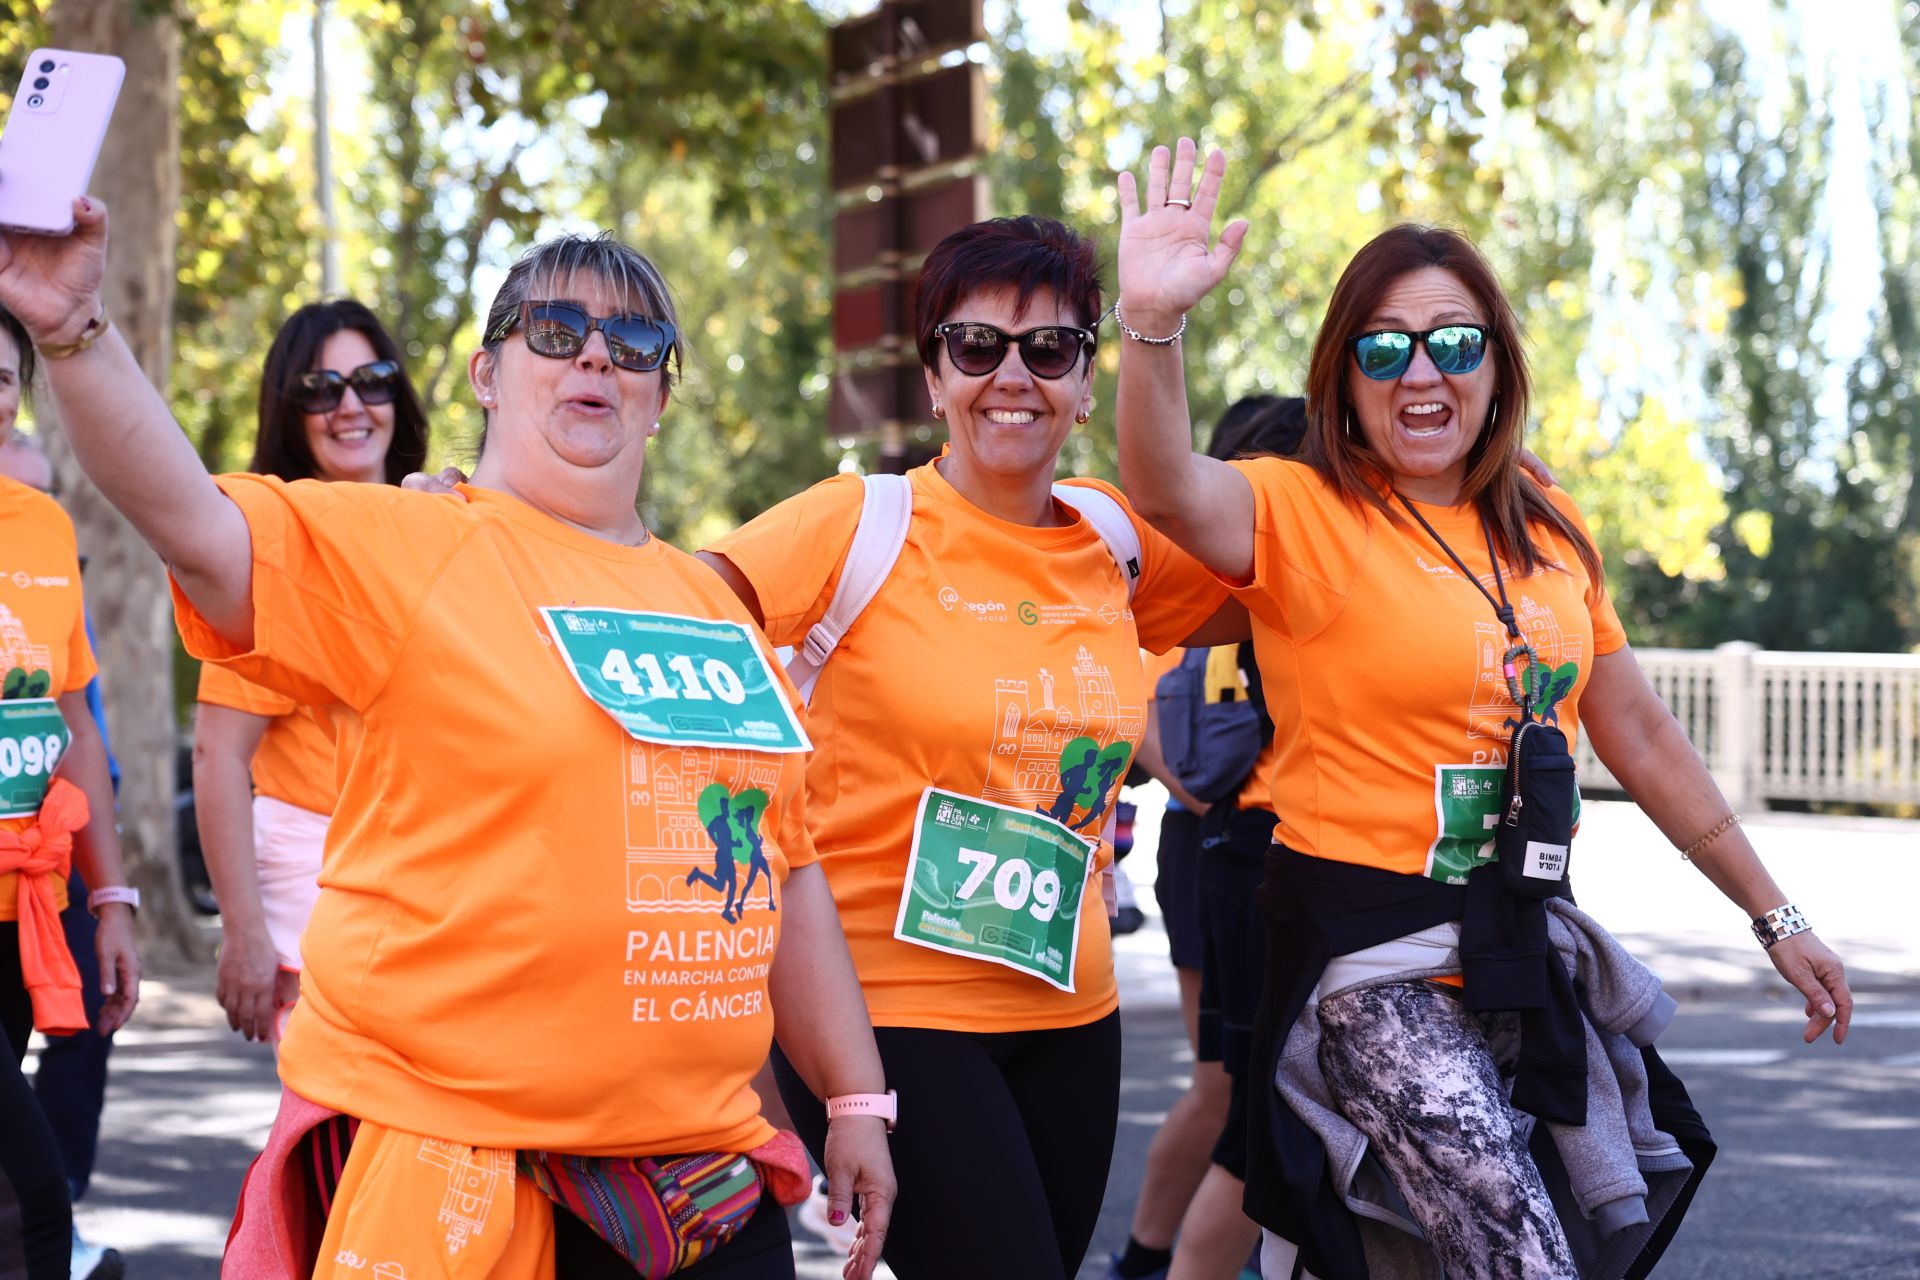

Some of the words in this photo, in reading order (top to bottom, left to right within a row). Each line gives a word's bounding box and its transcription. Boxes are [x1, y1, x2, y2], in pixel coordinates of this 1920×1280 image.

[601, 648, 745, 705] 4110
[1539, 852, 1562, 863] BIMBA
[955, 846, 1061, 922] 709
[921, 910, 960, 930] Palencia
[626, 925, 774, 961] PALENCIA
[624, 970, 646, 985] EN
[651, 970, 724, 985] MARCHA
[728, 963, 769, 983] CONTRA
[632, 998, 660, 1022] EL
[670, 990, 763, 1022] CÁNCER
